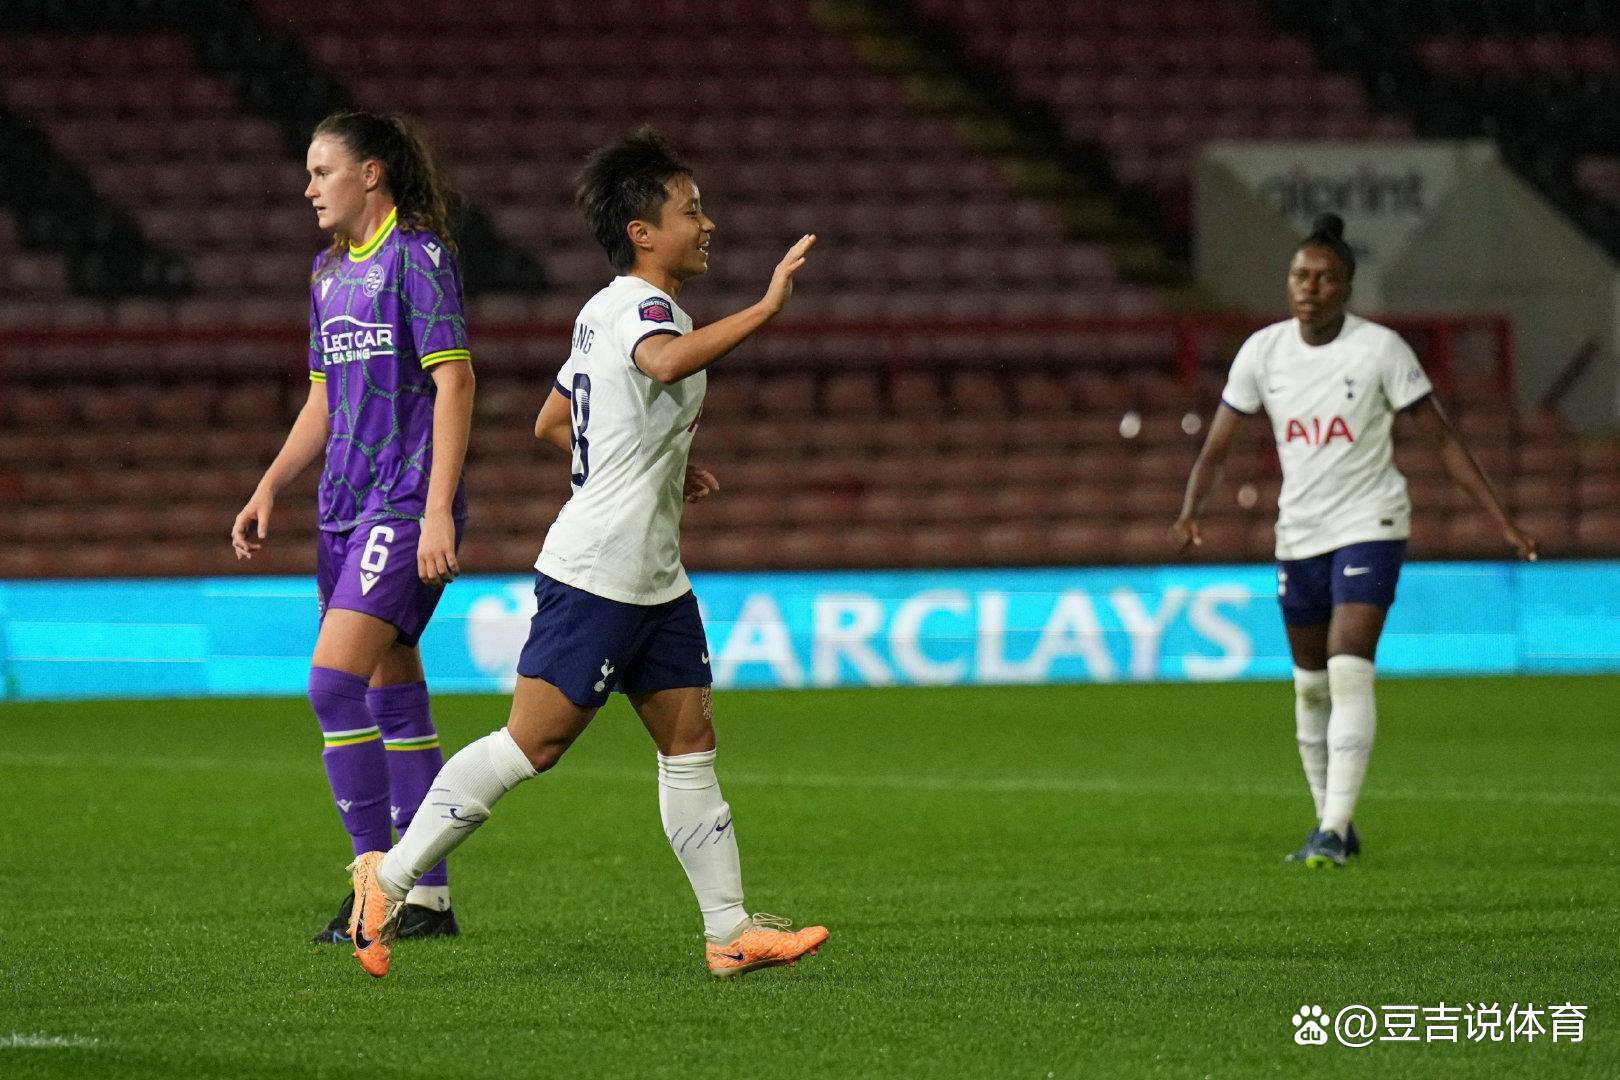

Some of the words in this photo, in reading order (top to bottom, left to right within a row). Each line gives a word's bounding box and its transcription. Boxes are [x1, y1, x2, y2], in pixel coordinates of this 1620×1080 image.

[323, 348, 371, 366] LEASING
[1286, 416, 1354, 445] AIA
[360, 525, 394, 573] 6
[704, 583, 1253, 687] ARCLAYS
